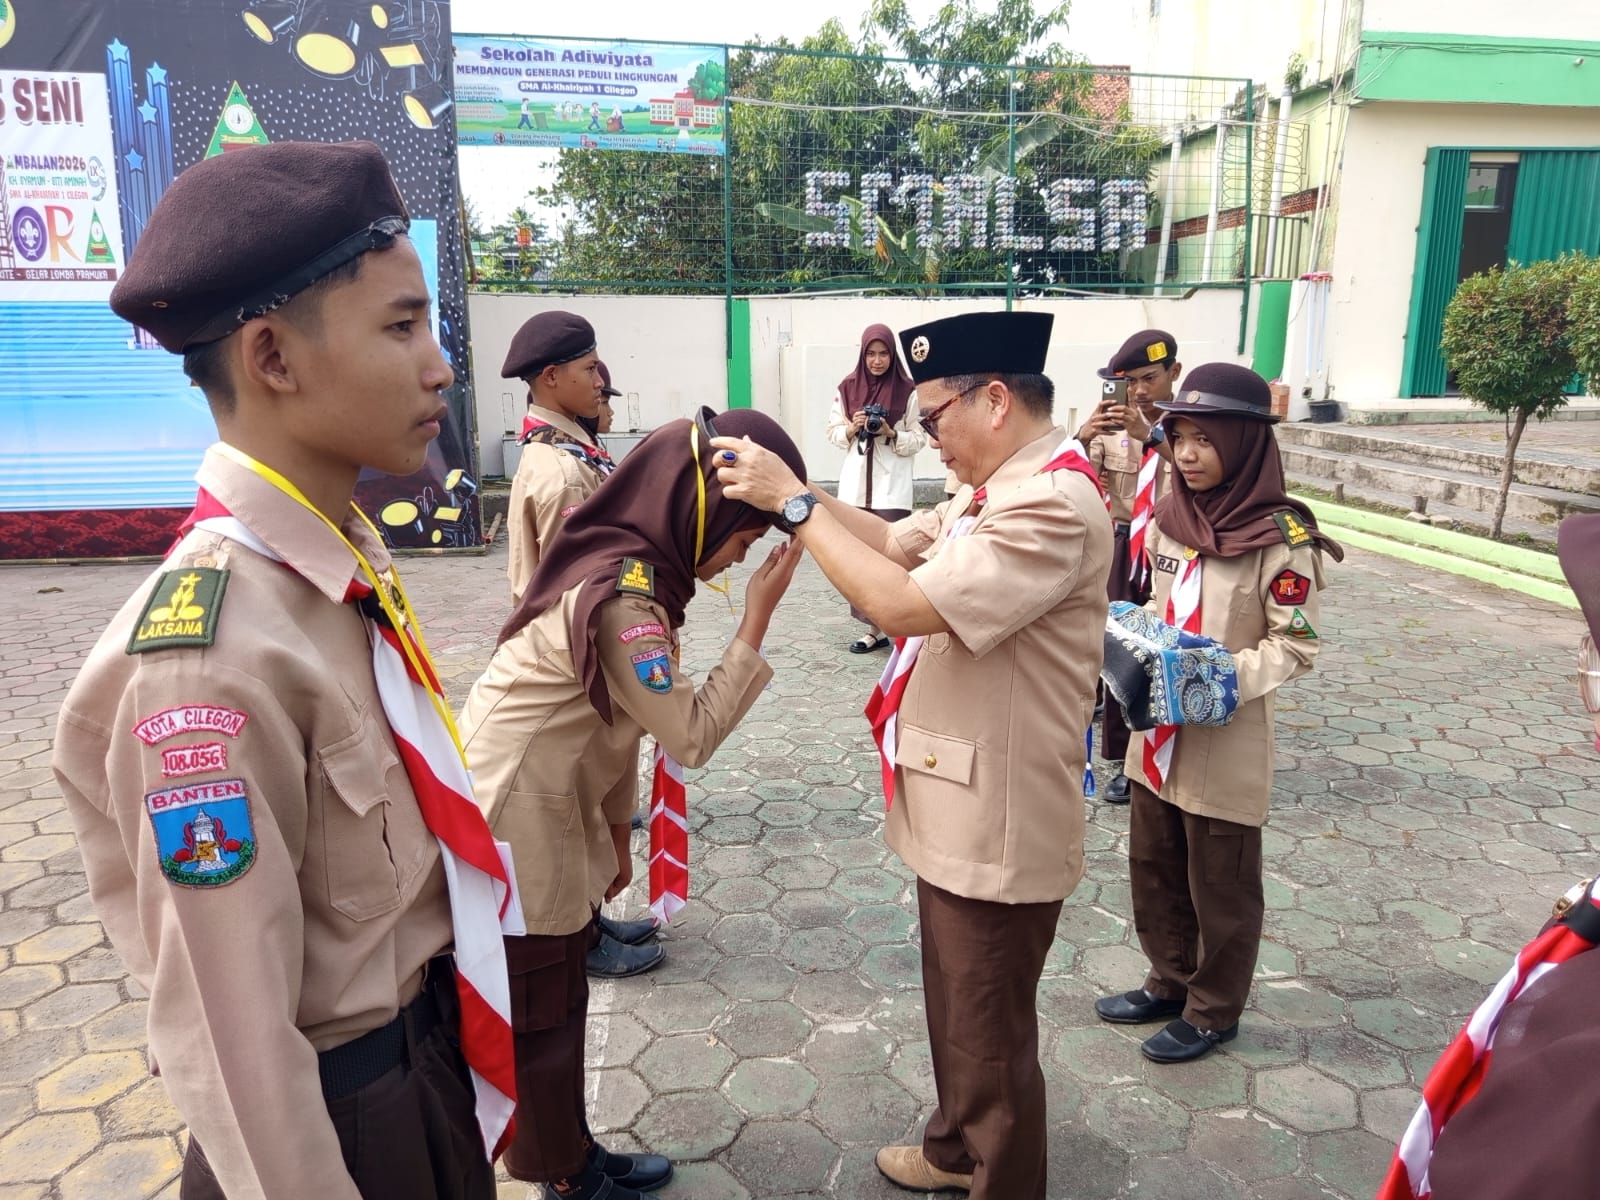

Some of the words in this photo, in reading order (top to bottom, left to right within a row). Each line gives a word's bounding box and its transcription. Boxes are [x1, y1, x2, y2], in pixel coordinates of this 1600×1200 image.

[480, 46, 555, 61] Sekolah
[561, 49, 653, 67] Adiwiyata
[456, 64, 522, 76] MEMBANGUN
[525, 68, 575, 78] GENERASI
[578, 69, 612, 80] PEDULI
[614, 71, 678, 83] LINGKUNGAN
[13, 78, 84, 123] SENI
[520, 82, 539, 91] SMA
[596, 84, 601, 93] 1
[604, 85, 636, 95] Cilegon
[804, 171, 1147, 252] SMALSA
[137, 620, 204, 641] LAKSANA
[141, 716, 176, 741] KOTA
[184, 707, 240, 732] CILEGON
[168, 748, 220, 772] 08.056
[152, 782, 241, 810] BANTEN
